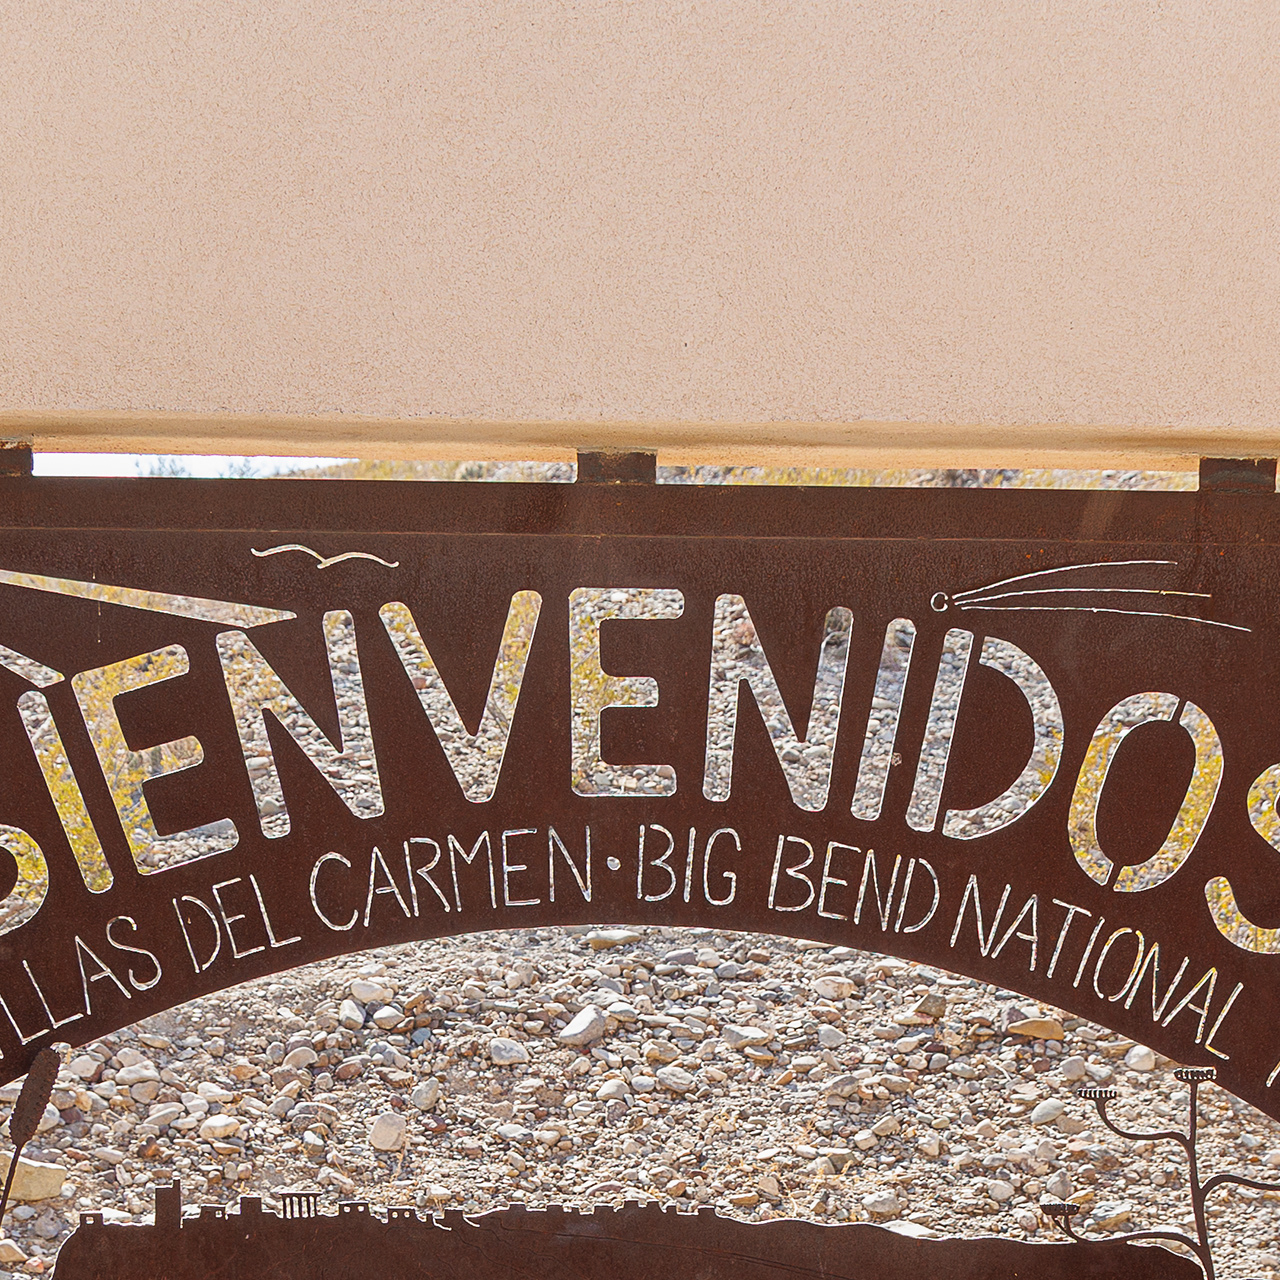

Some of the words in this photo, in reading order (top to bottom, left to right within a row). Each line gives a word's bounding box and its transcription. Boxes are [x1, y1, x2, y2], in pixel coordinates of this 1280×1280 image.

[172, 872, 302, 975] DEL
[308, 825, 593, 932] CARMEN
[637, 825, 742, 906] BIG
[767, 834, 940, 935] BEND
[950, 873, 1246, 1062] NATIONAL
